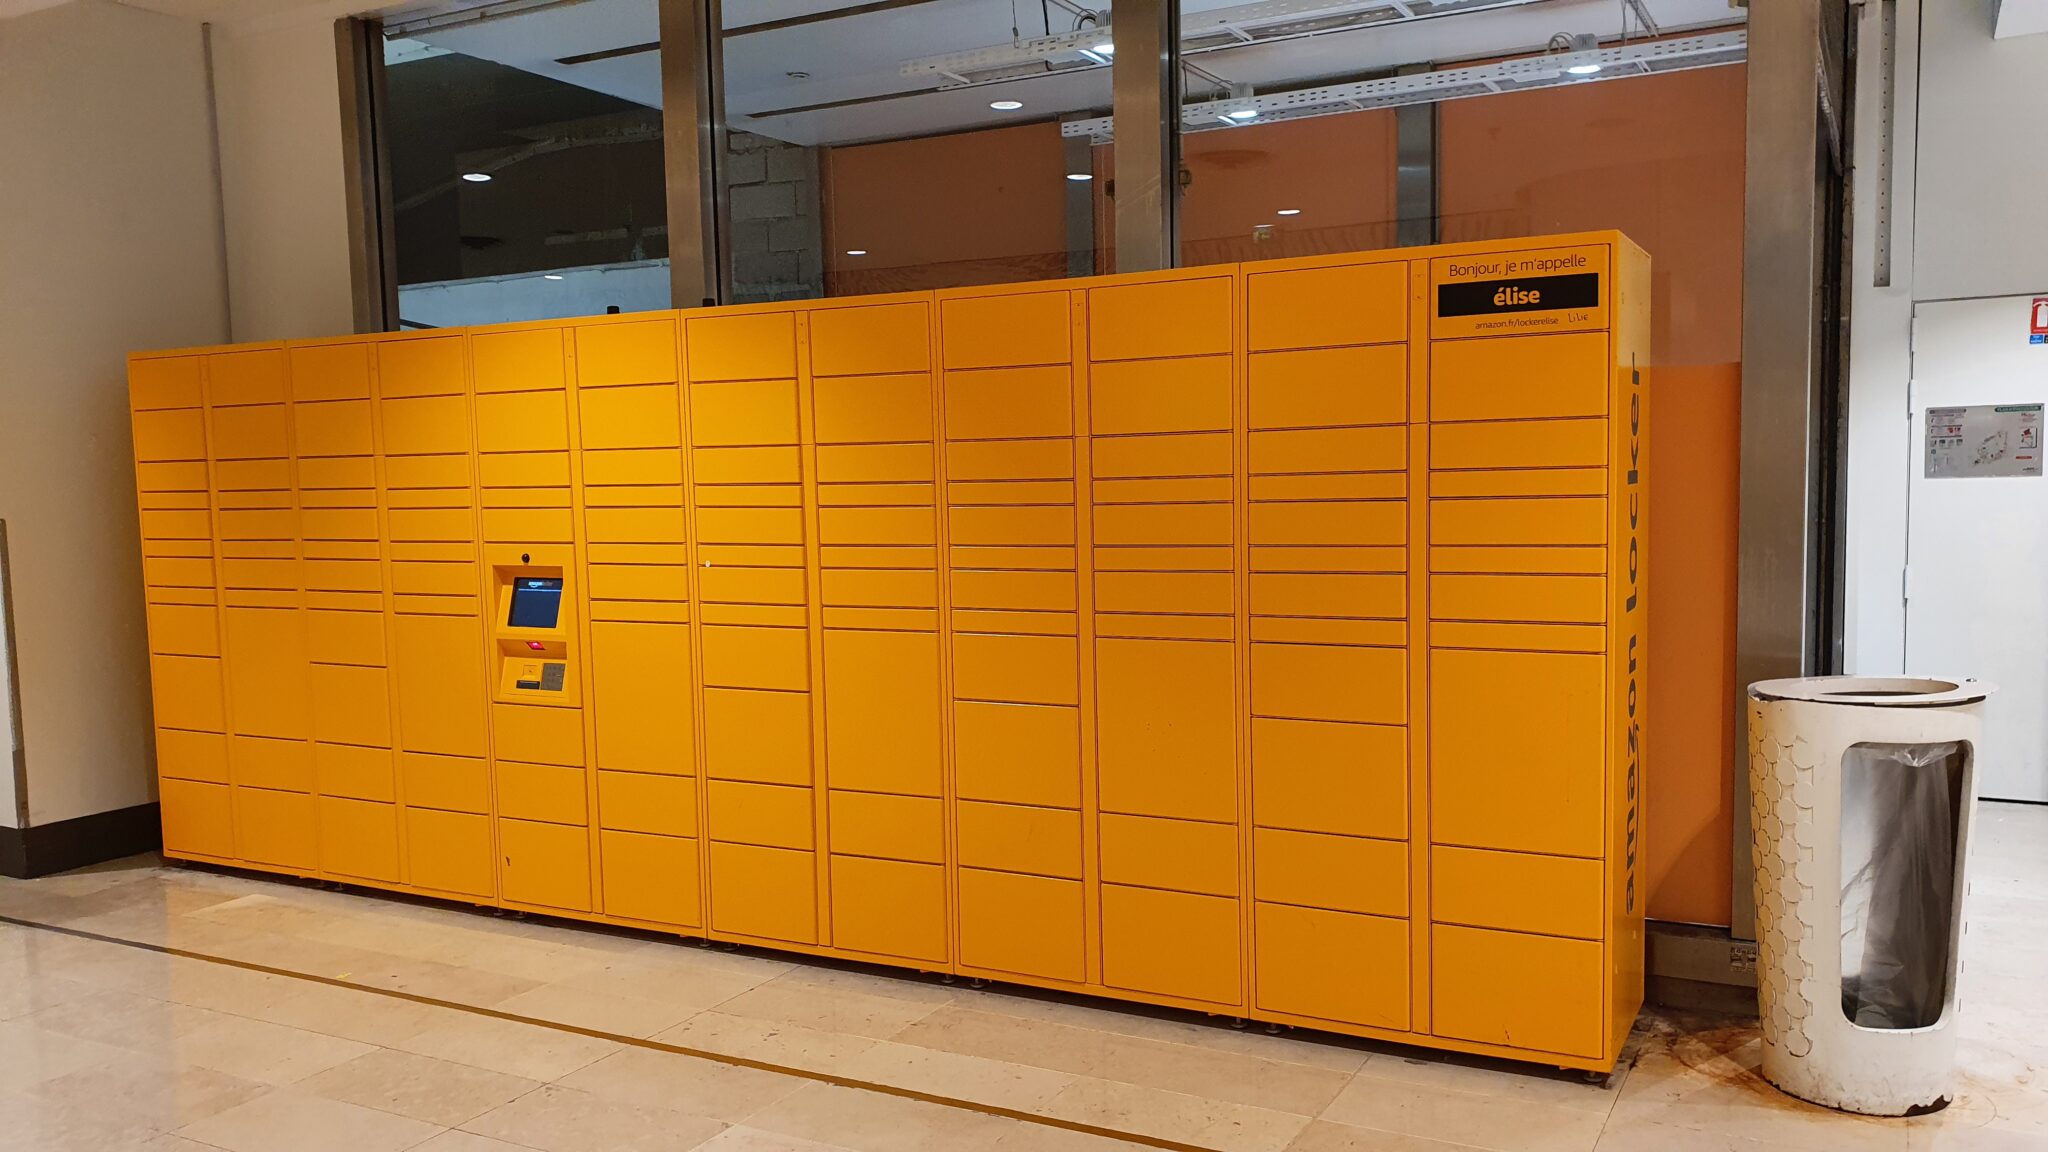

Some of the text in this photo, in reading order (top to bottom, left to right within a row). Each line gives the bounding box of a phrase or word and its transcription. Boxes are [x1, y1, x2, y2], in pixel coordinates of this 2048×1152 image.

[1449, 254, 1586, 279] Bonjour, je m'appelle
[1493, 286, 1541, 306] élise
[1475, 317, 1559, 330] amazon.fr/lockerelise
[1626, 352, 1640, 915] amazon locker
